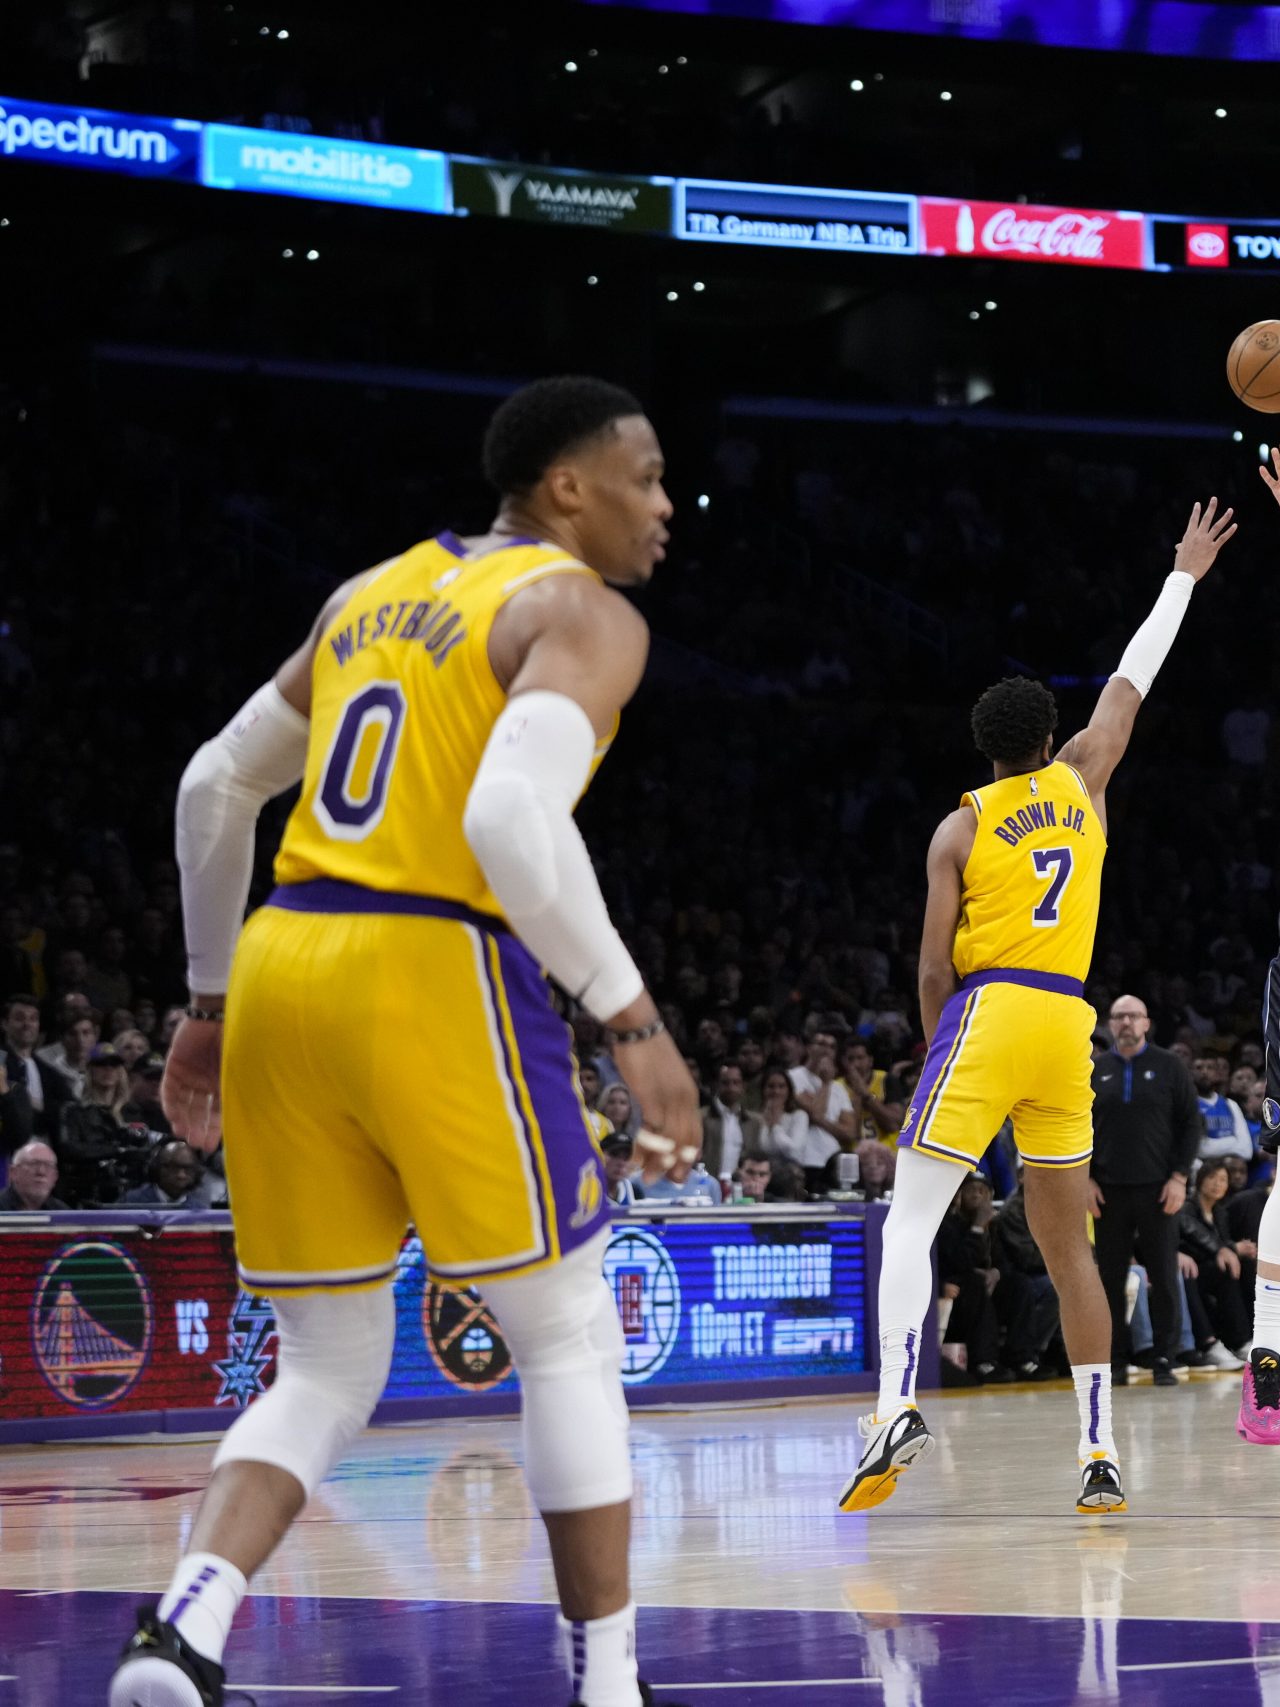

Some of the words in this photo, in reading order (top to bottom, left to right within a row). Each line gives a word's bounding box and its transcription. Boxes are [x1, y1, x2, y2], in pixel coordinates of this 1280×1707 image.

[241, 146, 412, 188] mobilitie
[687, 212, 720, 233] TR
[721, 215, 814, 242] Germany
[815, 222, 865, 244] NBA
[865, 225, 907, 248] Trip
[312, 679, 407, 842] 0
[994, 801, 1057, 847] BROWN
[1062, 805, 1085, 836] JR.
[1030, 846, 1075, 928] 7
[712, 1244, 832, 1300] TOMORROW
[175, 1299, 209, 1355] VS
[772, 1317, 855, 1356] ESPN
